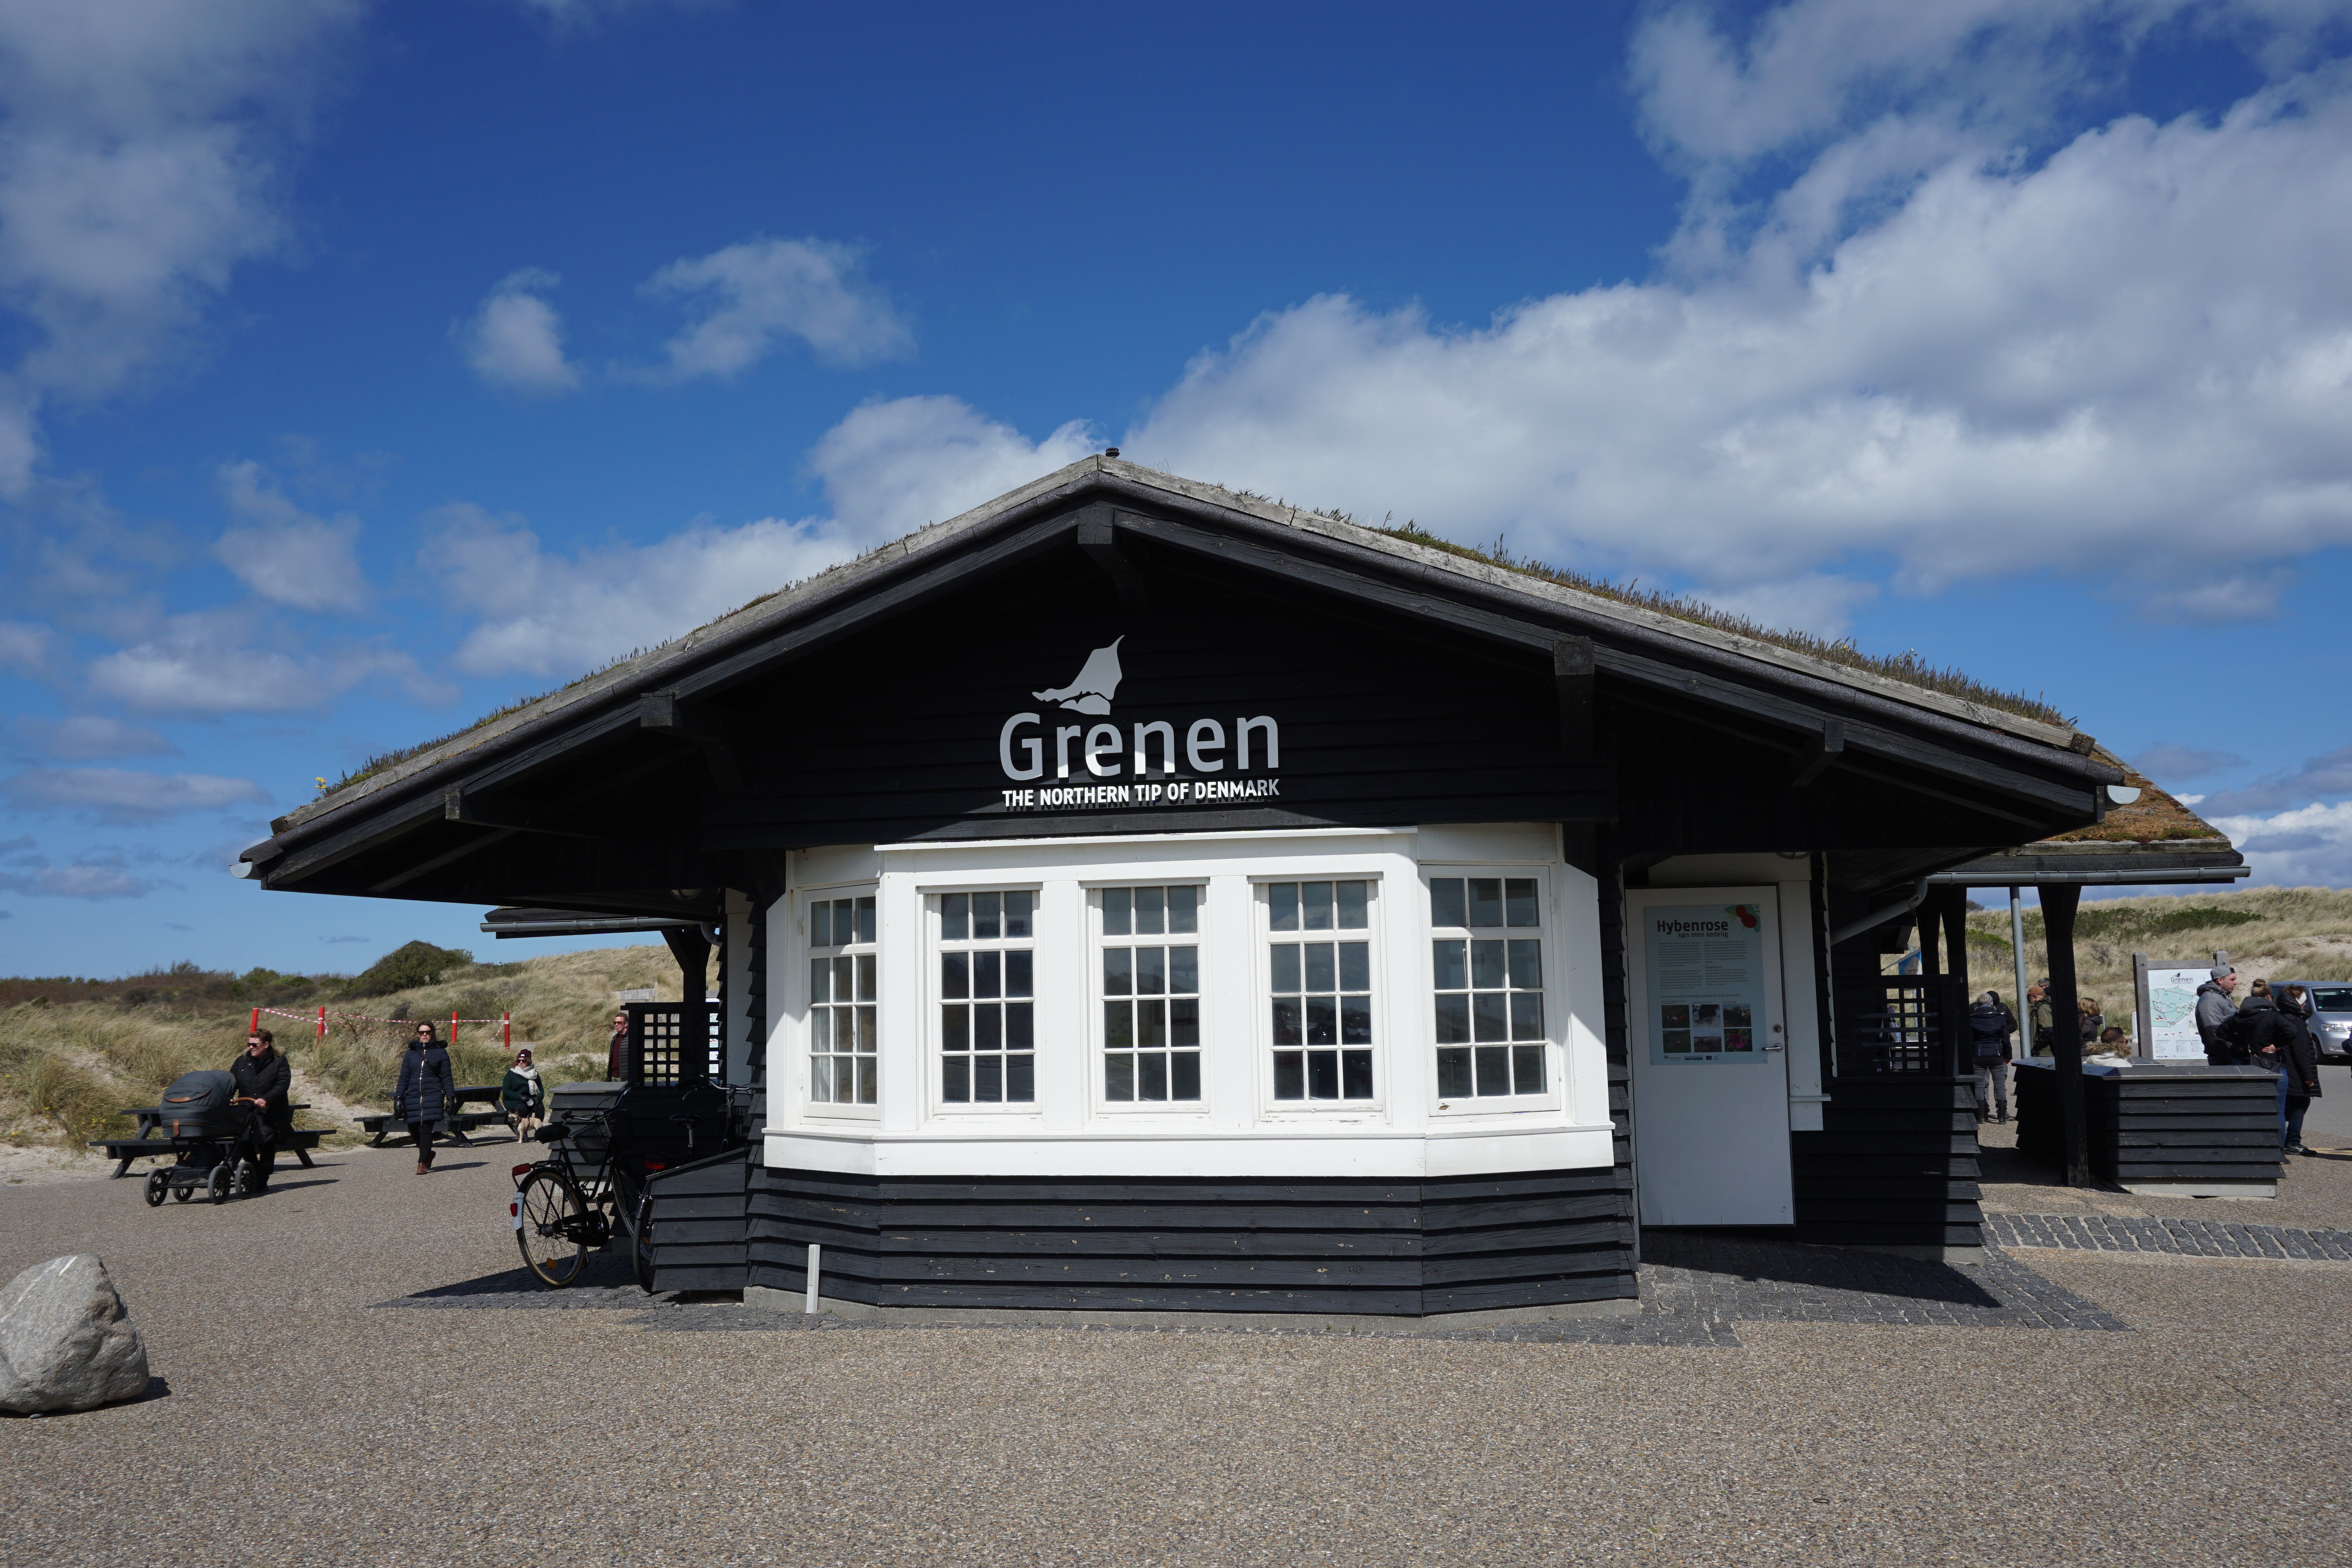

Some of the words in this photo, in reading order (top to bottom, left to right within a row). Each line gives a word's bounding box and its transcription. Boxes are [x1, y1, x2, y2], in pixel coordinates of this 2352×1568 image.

[1000, 713, 1279, 780] Grenen
[1002, 789, 1034, 807] THE
[1040, 785, 1129, 806] NORTHERN
[1134, 784, 1162, 802] TIP
[1167, 783, 1189, 801] OF
[1195, 779, 1280, 799] DENMARK
[1657, 920, 1728, 935] Hybenrose
